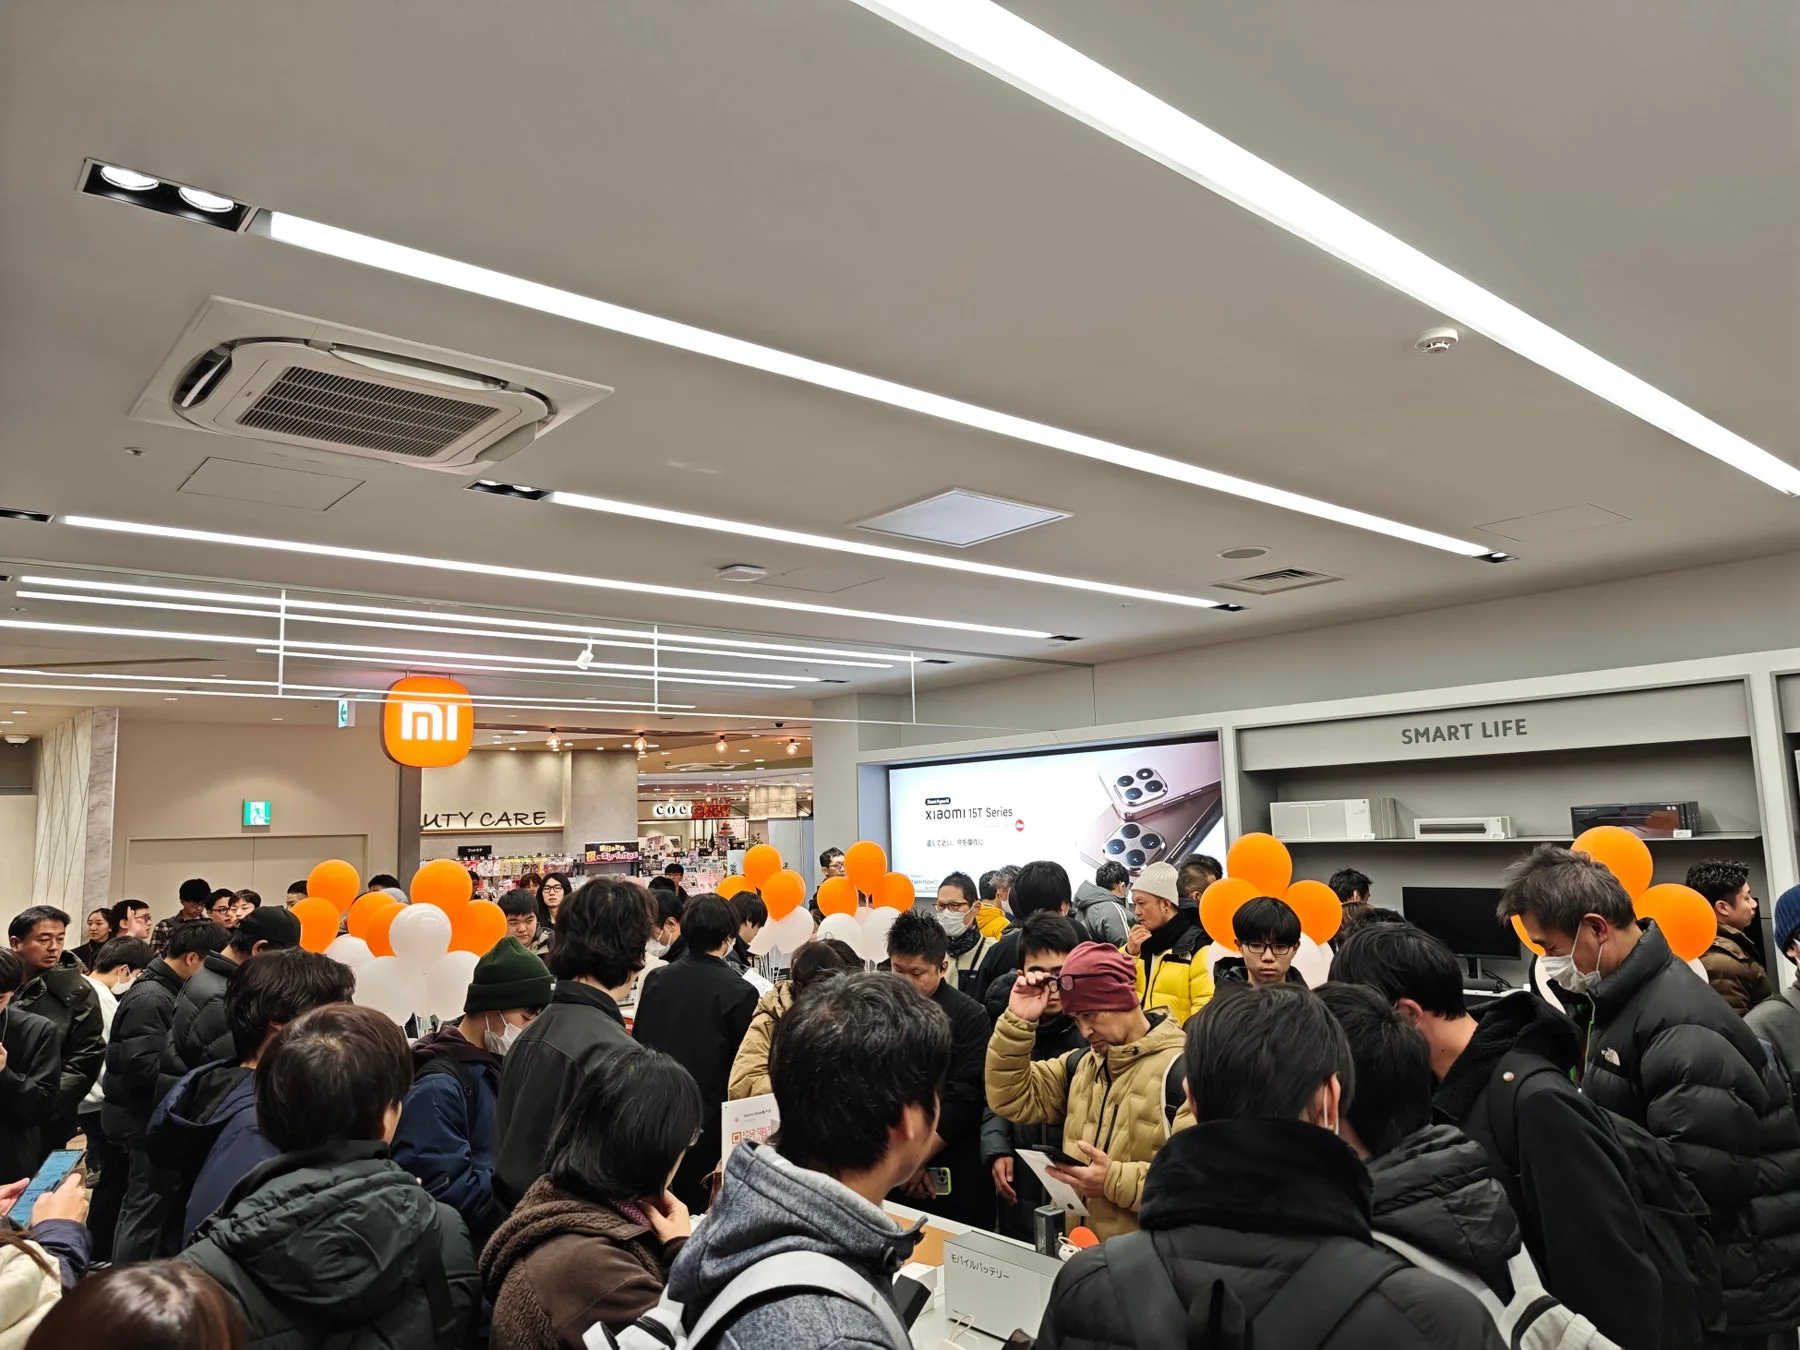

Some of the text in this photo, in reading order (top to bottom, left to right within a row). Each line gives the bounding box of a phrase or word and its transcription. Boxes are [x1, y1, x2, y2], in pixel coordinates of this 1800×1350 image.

[1401, 718, 1528, 745] SMART LIFE
[480, 811, 546, 827] CARE
[968, 807, 983, 819] 15T
[985, 806, 1013, 818] Series
[950, 1253, 1010, 1279] モバイルバッテリー
